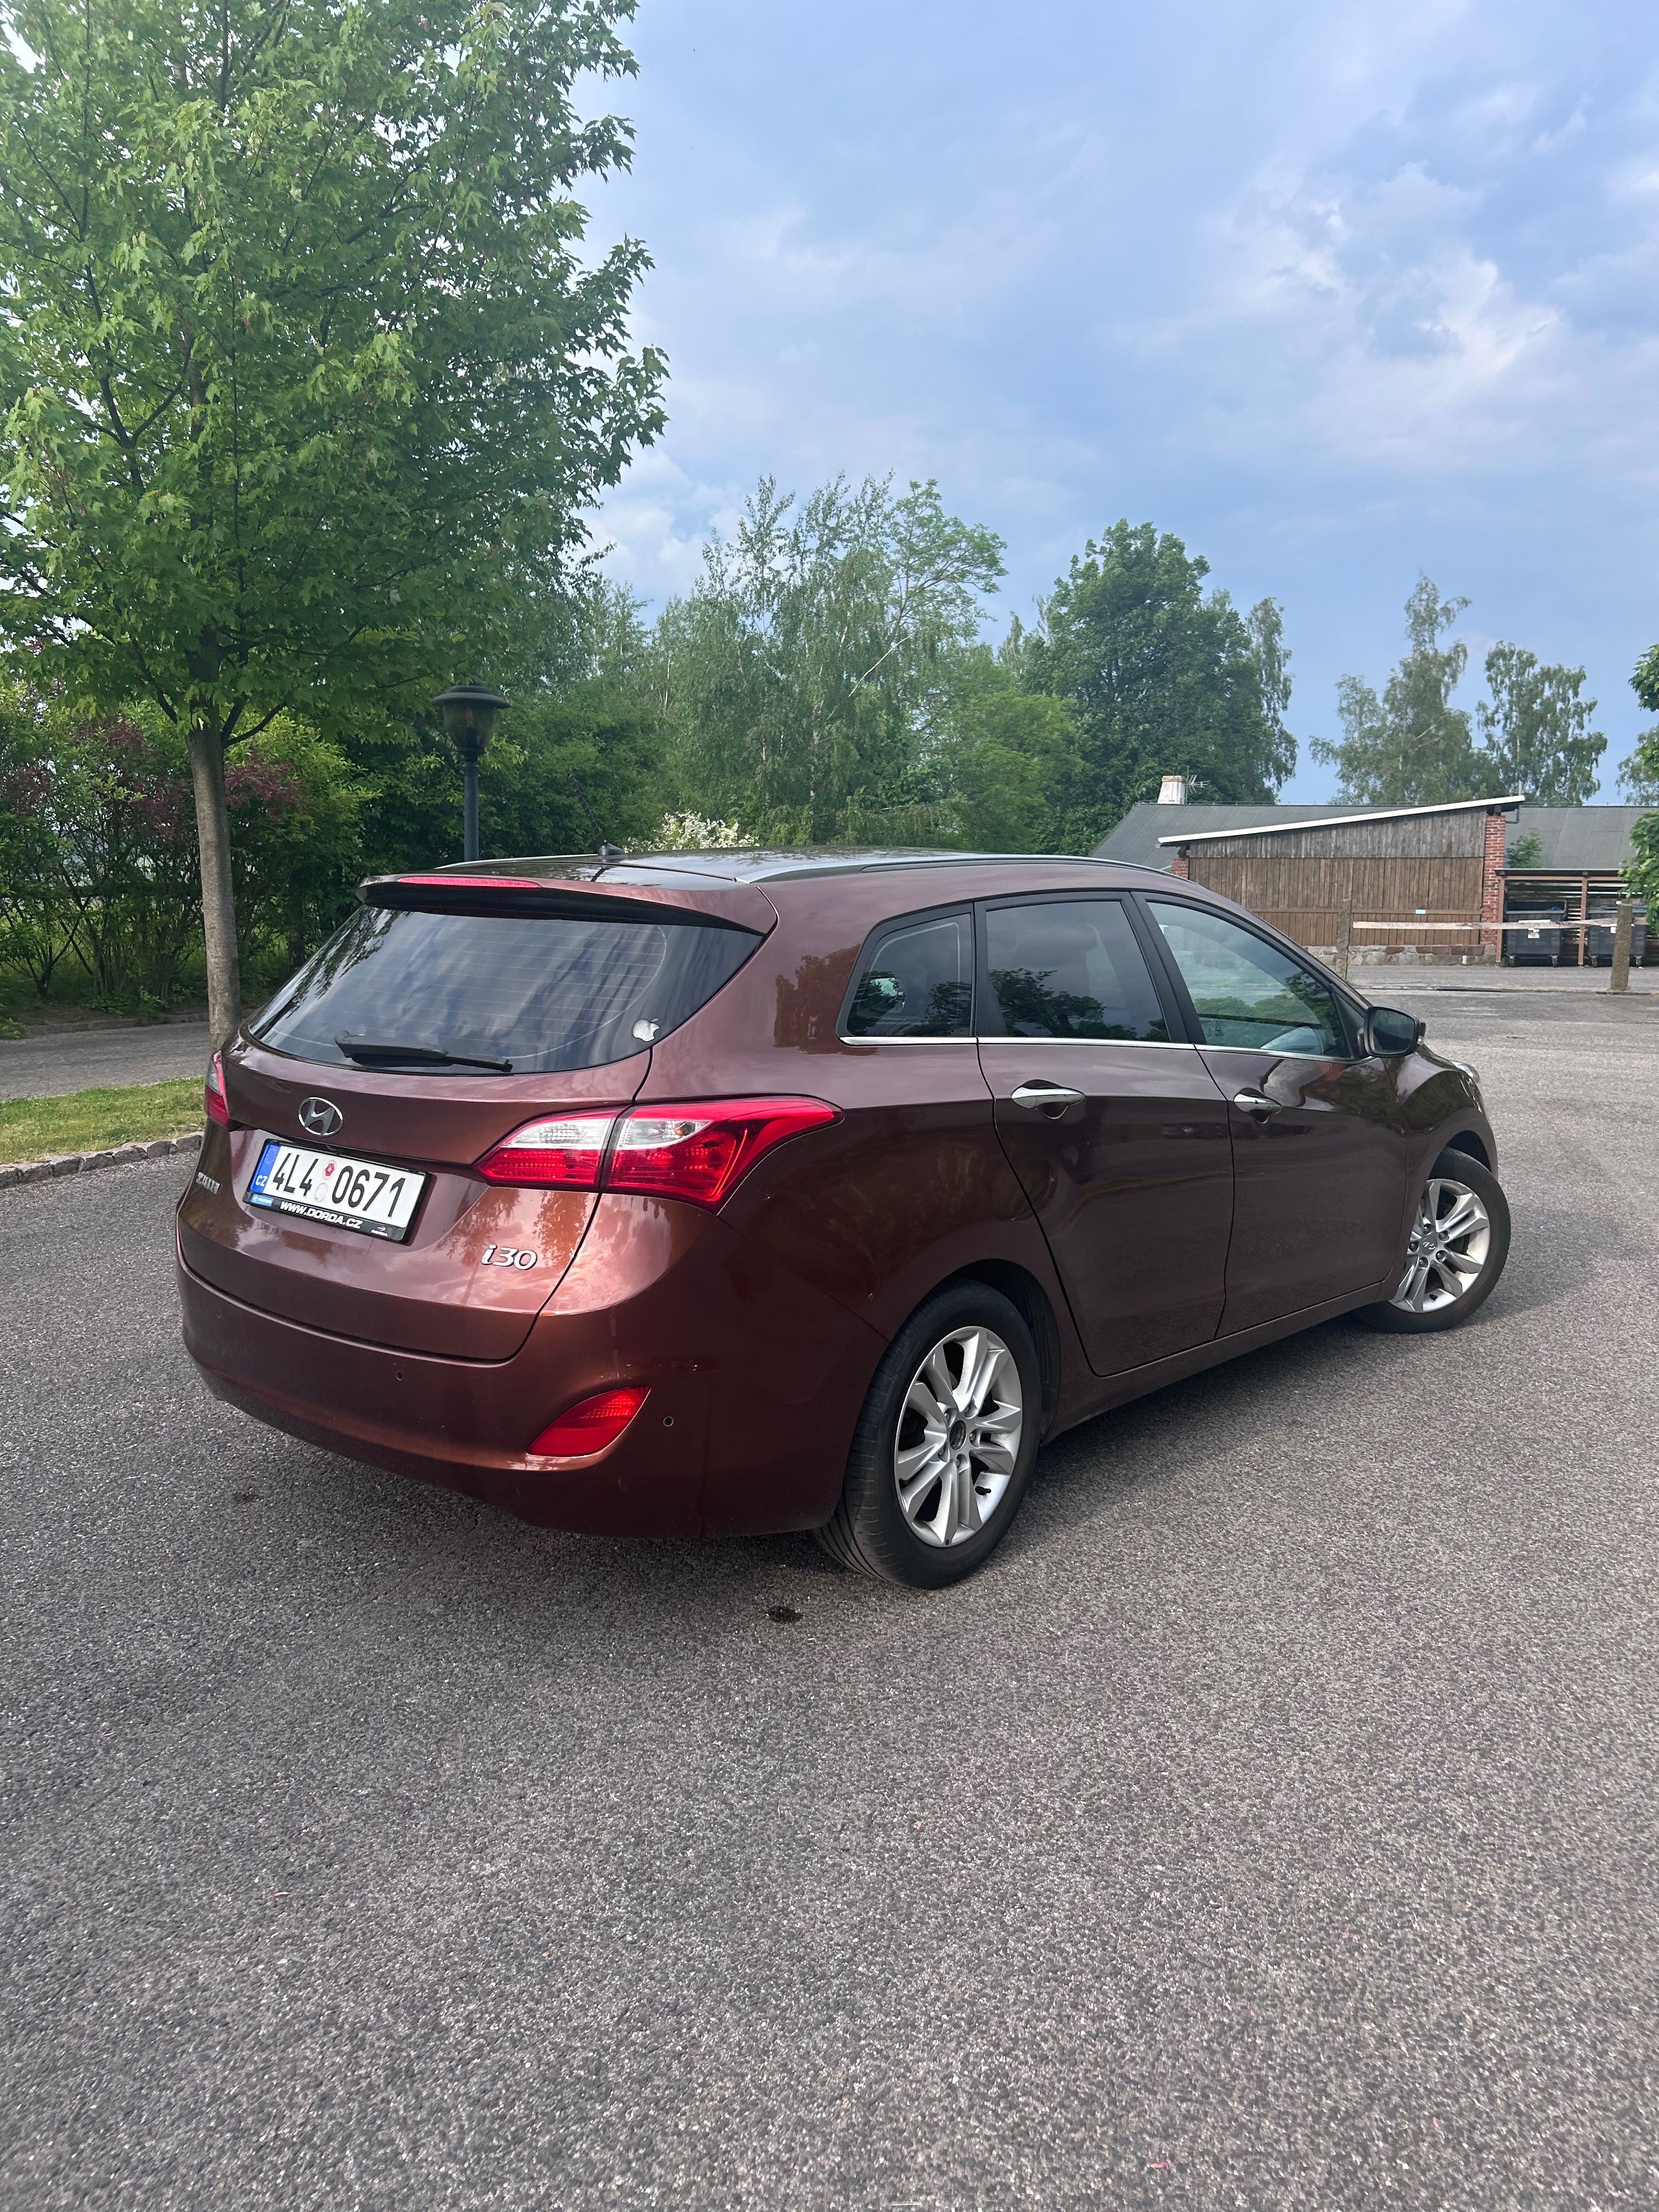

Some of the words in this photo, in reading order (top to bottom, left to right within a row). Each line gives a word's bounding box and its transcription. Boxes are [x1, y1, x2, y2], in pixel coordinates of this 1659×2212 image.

[255, 1175, 268, 1187] CZ
[273, 1153, 319, 1197] 4L4
[332, 1165, 406, 1217] 0671
[481, 1244, 538, 1271] i30
